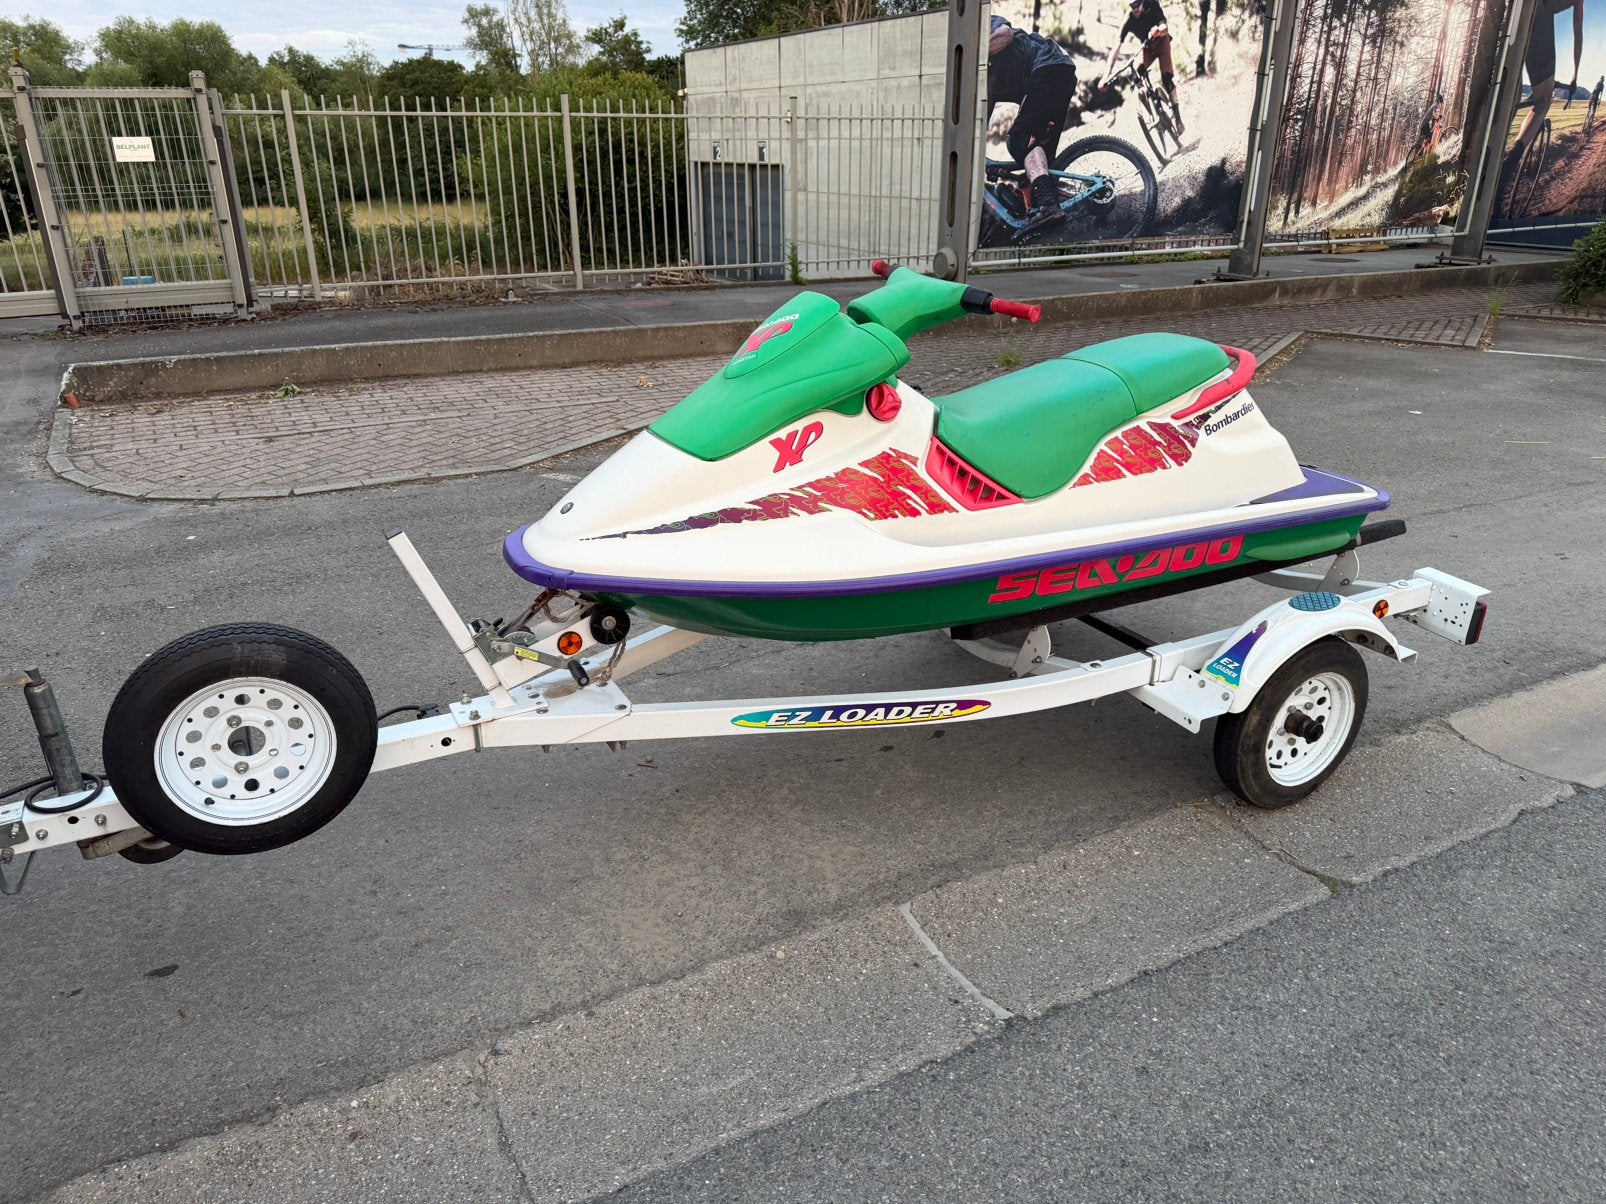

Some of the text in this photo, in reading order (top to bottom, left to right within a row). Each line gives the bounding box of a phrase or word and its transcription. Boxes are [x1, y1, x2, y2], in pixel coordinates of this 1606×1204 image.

[1204, 402, 1255, 436] Bombardier
[768, 421, 824, 473] XP
[1213, 663, 1238, 678] LOADER
[1220, 657, 1240, 669] EZ
[766, 702, 958, 727] EZ LOADER
